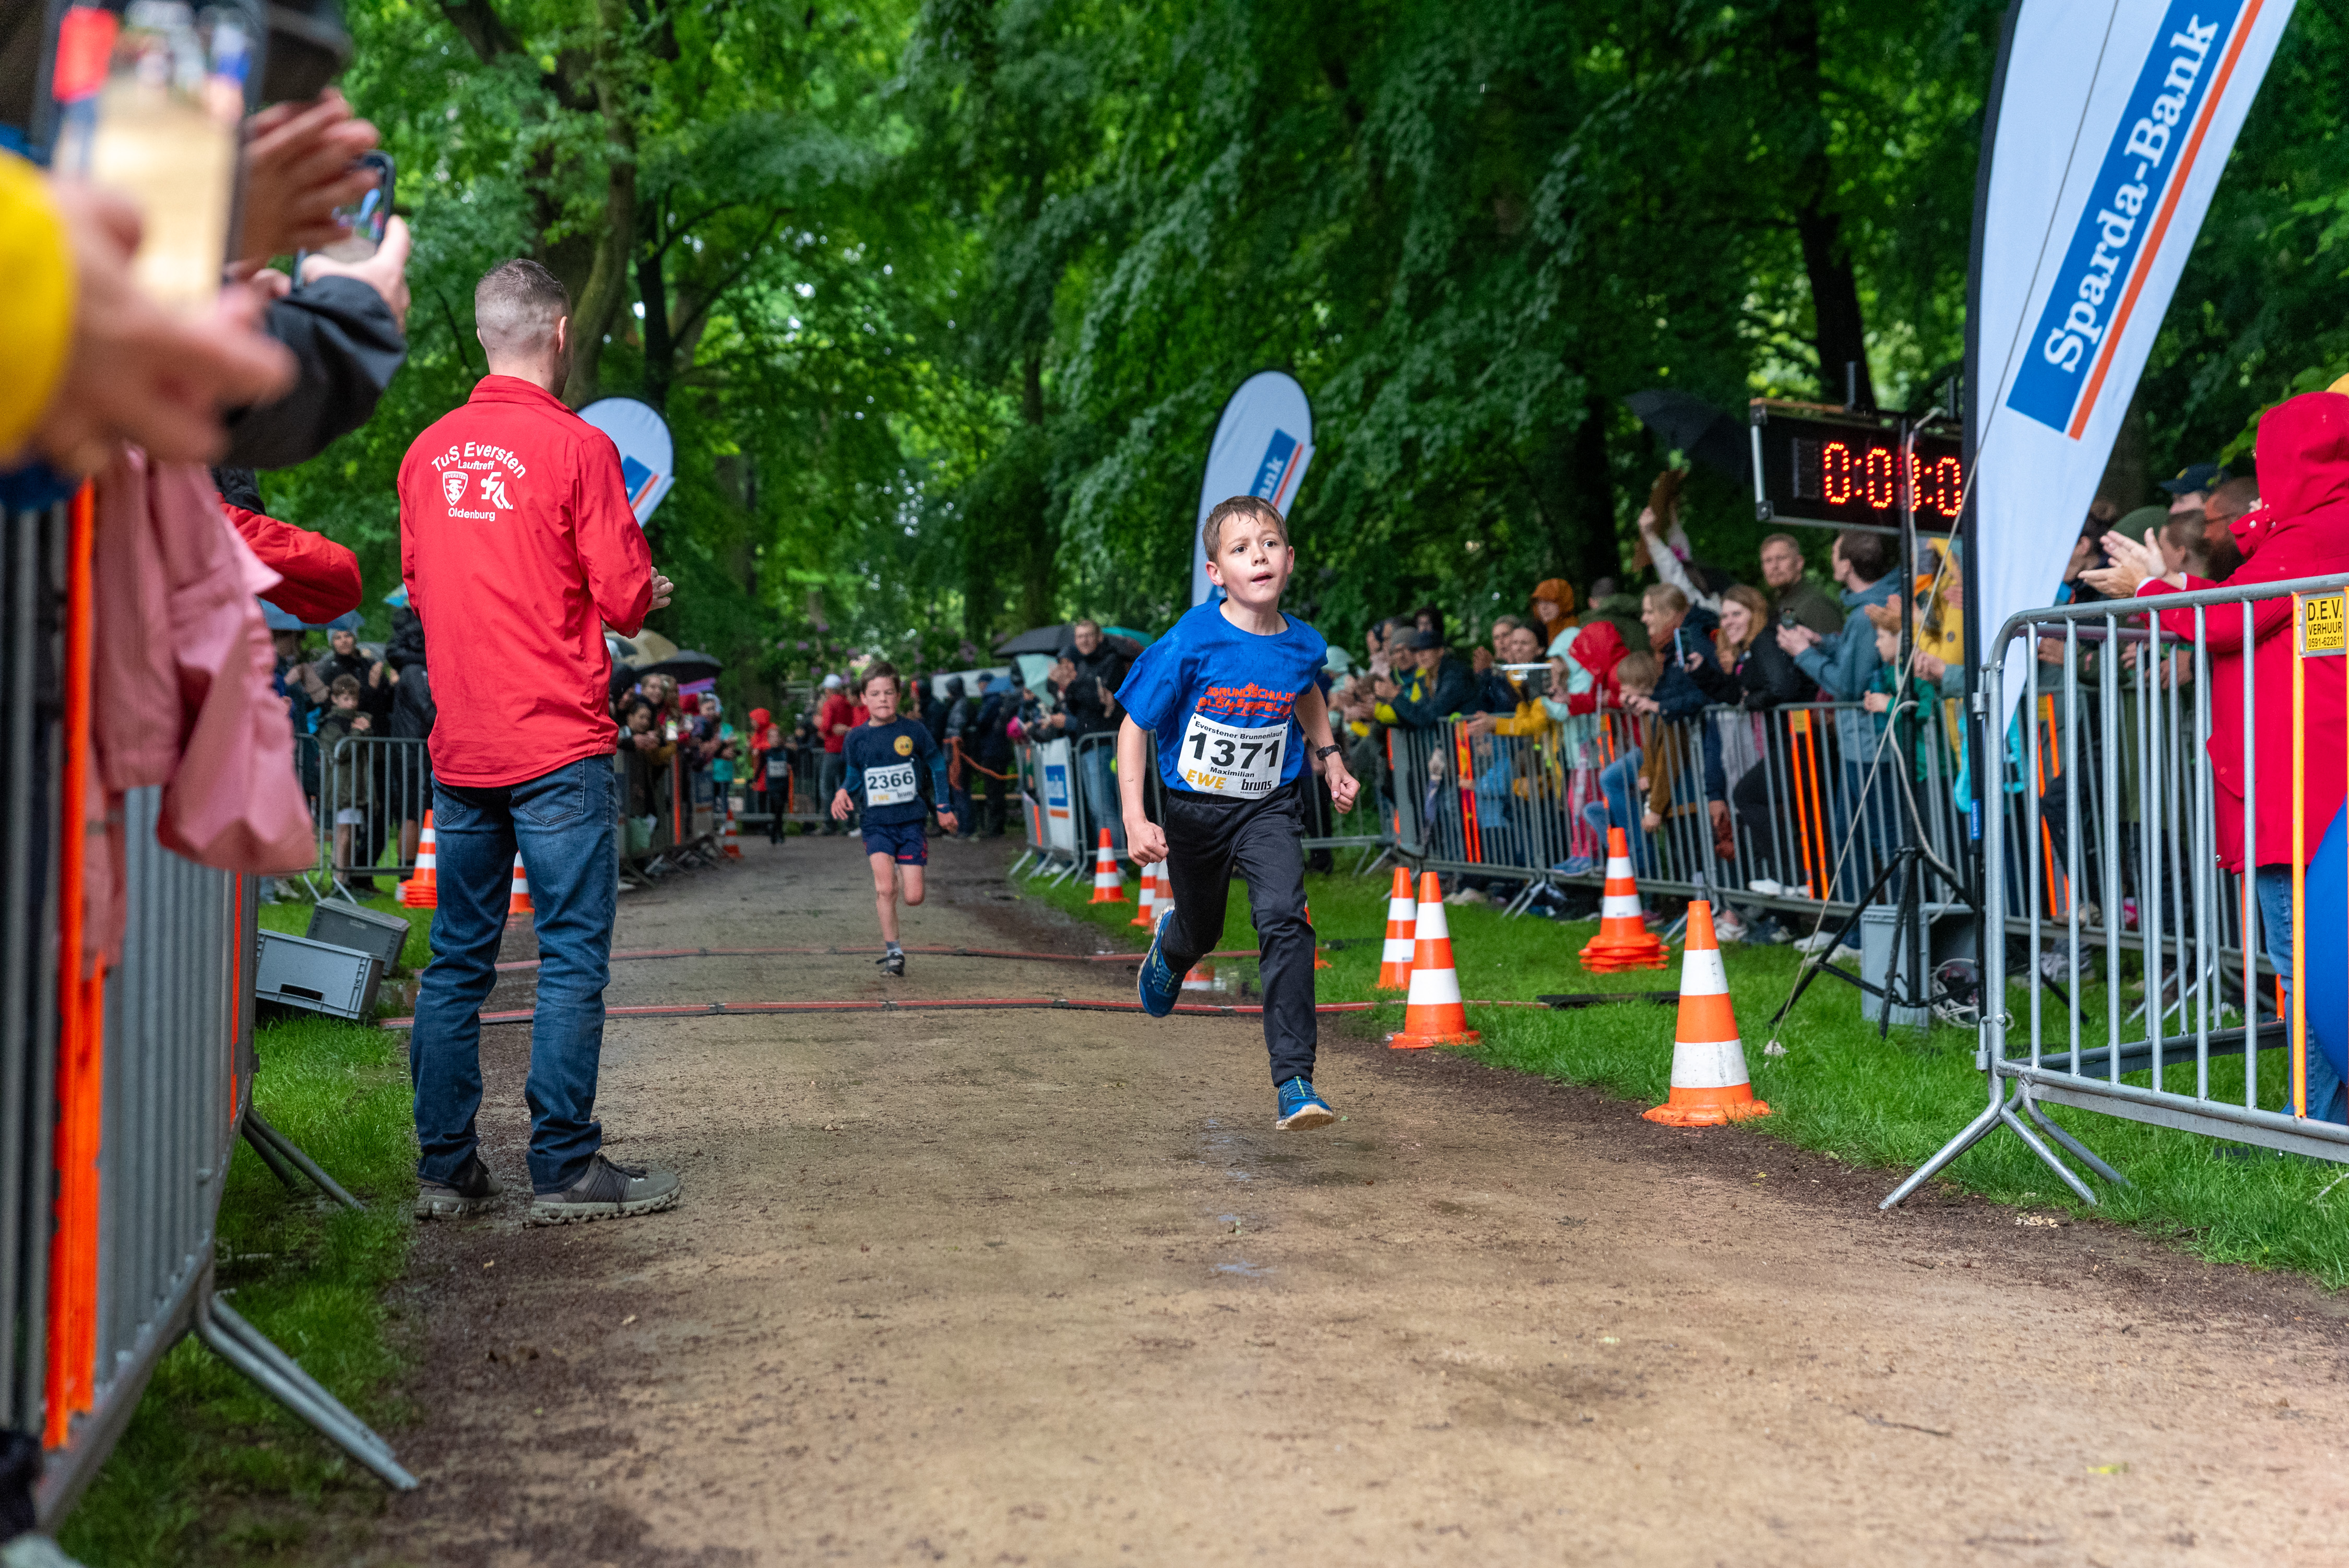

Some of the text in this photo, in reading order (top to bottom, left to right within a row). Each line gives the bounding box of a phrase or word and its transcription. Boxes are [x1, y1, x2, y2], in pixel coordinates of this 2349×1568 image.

[2044, 14, 2220, 373] Sparda-Bank
[431, 441, 526, 479] TuS Eversten
[457, 459, 495, 470] Lauftreff
[448, 507, 495, 521] Oldenburg
[2308, 599, 2342, 621] D.E.V.
[2308, 621, 2343, 636] VERHUUR
[2308, 635, 2343, 648] 0591-622611
[1195, 721, 1283, 740] Everstener Brunnenlauf
[1189, 732, 1280, 769] 1371
[868, 771, 914, 790] 2366
[1185, 769, 1272, 791] EWE bruns
[1210, 767, 1254, 778] Maximilian
